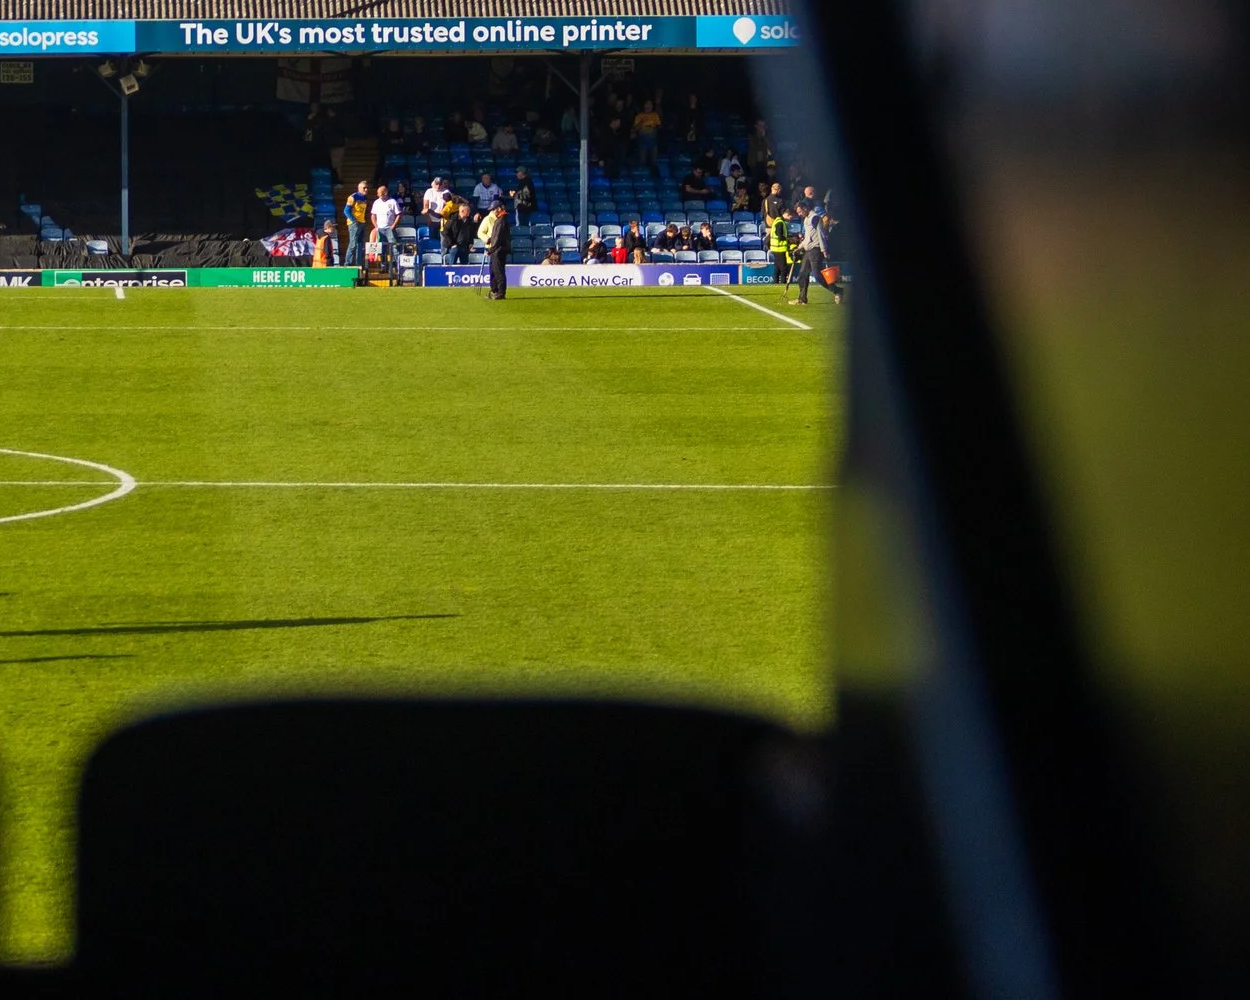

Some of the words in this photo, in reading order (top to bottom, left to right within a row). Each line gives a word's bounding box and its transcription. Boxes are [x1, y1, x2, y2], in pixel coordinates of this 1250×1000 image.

[0, 26, 99, 50] solopress
[180, 22, 228, 44] The
[236, 22, 292, 44] UK's
[299, 23, 366, 44] most
[371, 20, 465, 43] trusted
[473, 19, 556, 43] online
[562, 18, 652, 47] printer
[253, 270, 281, 283] HERE
[284, 270, 306, 283] FOR
[530, 275, 565, 287] Score
[568, 275, 578, 286] A
[581, 275, 609, 286] New
[612, 275, 634, 286] Car
